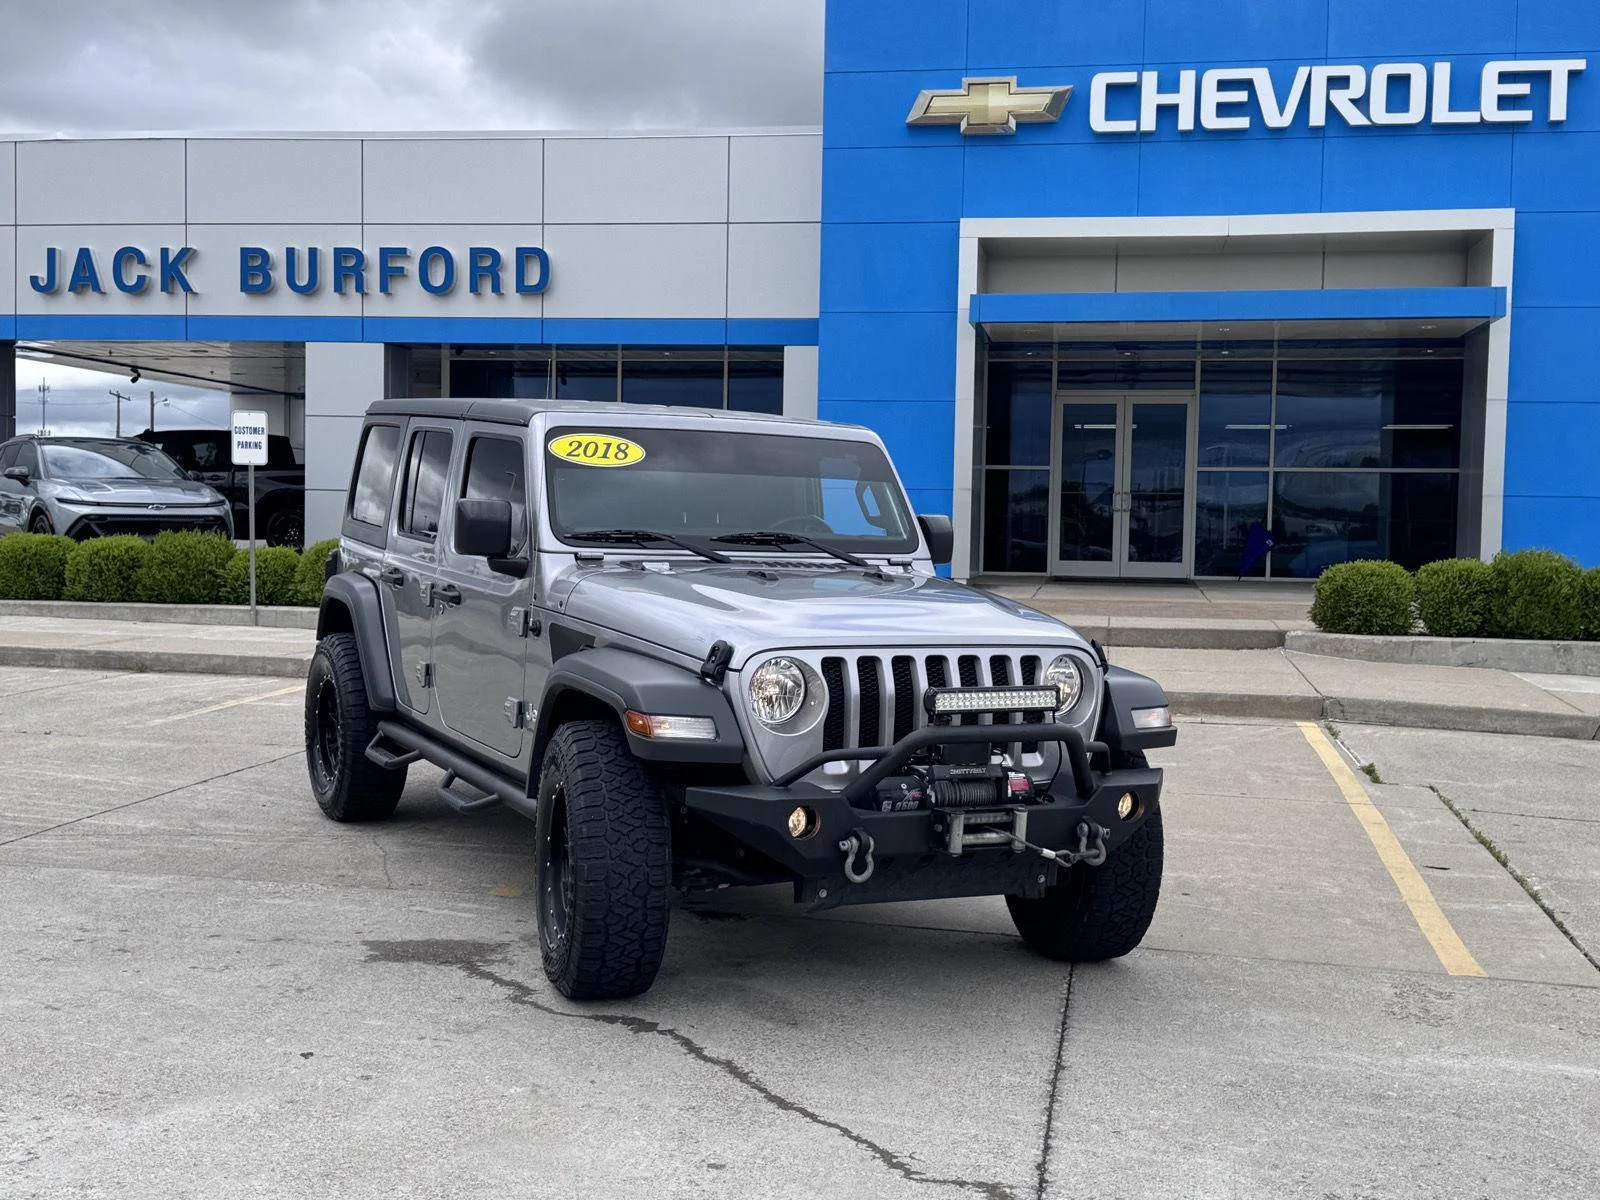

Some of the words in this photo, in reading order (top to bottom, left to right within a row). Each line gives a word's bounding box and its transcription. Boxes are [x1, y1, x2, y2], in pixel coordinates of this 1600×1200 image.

[1089, 58, 1587, 134] CHEVROLET
[30, 246, 197, 294] JACK
[239, 246, 551, 295] BURFORD
[234, 426, 265, 435] CUSTOMER
[237, 441, 262, 450] PARKING
[566, 440, 630, 461] 2018
